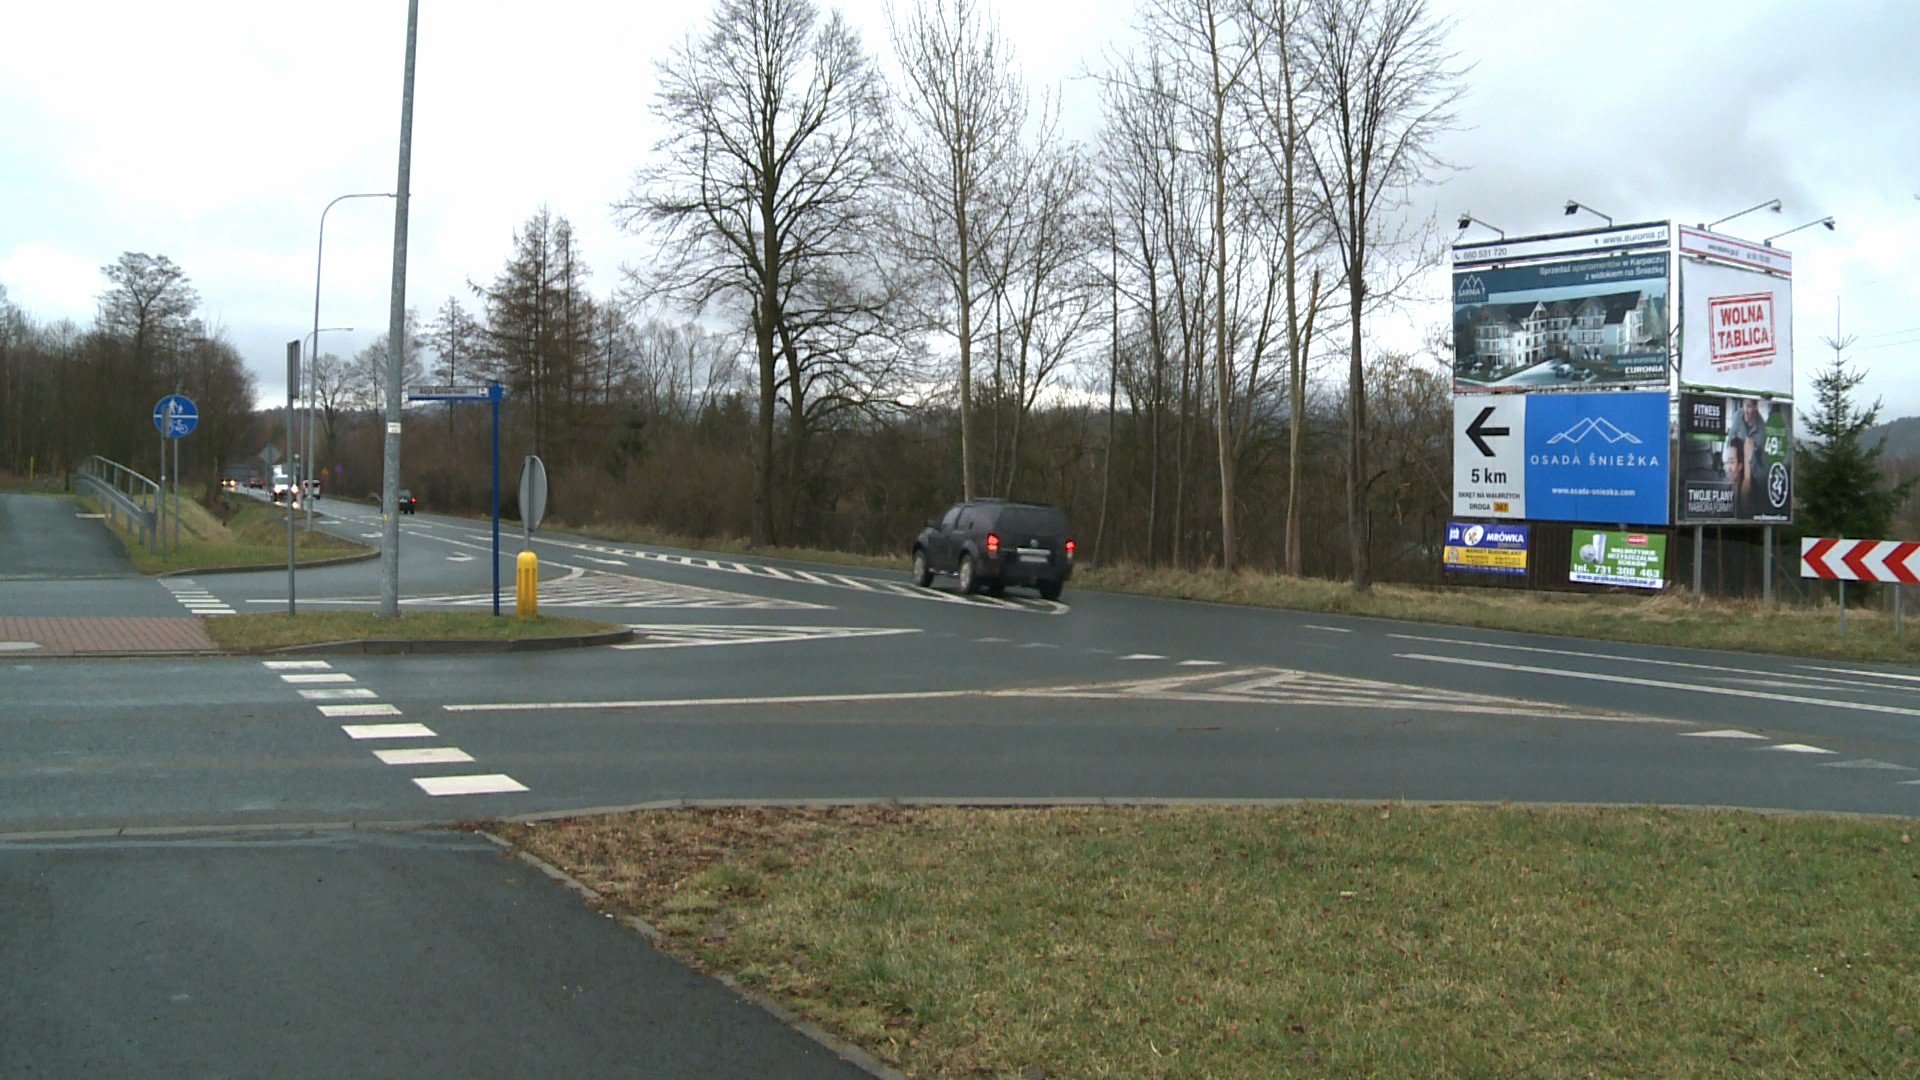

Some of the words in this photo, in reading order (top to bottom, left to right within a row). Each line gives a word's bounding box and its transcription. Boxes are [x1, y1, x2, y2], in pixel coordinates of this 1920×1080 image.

[1463, 250, 1477, 259] 660
[1478, 249, 1491, 258] 531
[1494, 247, 1507, 256] 720
[1720, 304, 1764, 326] WOLNA
[1717, 327, 1769, 349] TABLICA
[1624, 364, 1665, 375] EURONIA
[1693, 403, 1721, 416] FITNESS
[1764, 436, 1779, 455] 49
[1530, 454, 1581, 465] OSADA
[1588, 452, 1659, 466] ŚNIEŻKA
[1471, 468, 1480, 484] 5
[1484, 467, 1507, 484] km
[1688, 489, 1712, 501] TWOJE
[1712, 490, 1734, 501] PLANY
[1469, 503, 1491, 511] DROGA
[1486, 531, 1525, 543] MRÓWKA
[1573, 563, 1590, 573] tel.
[1594, 564, 1612, 574] 731
